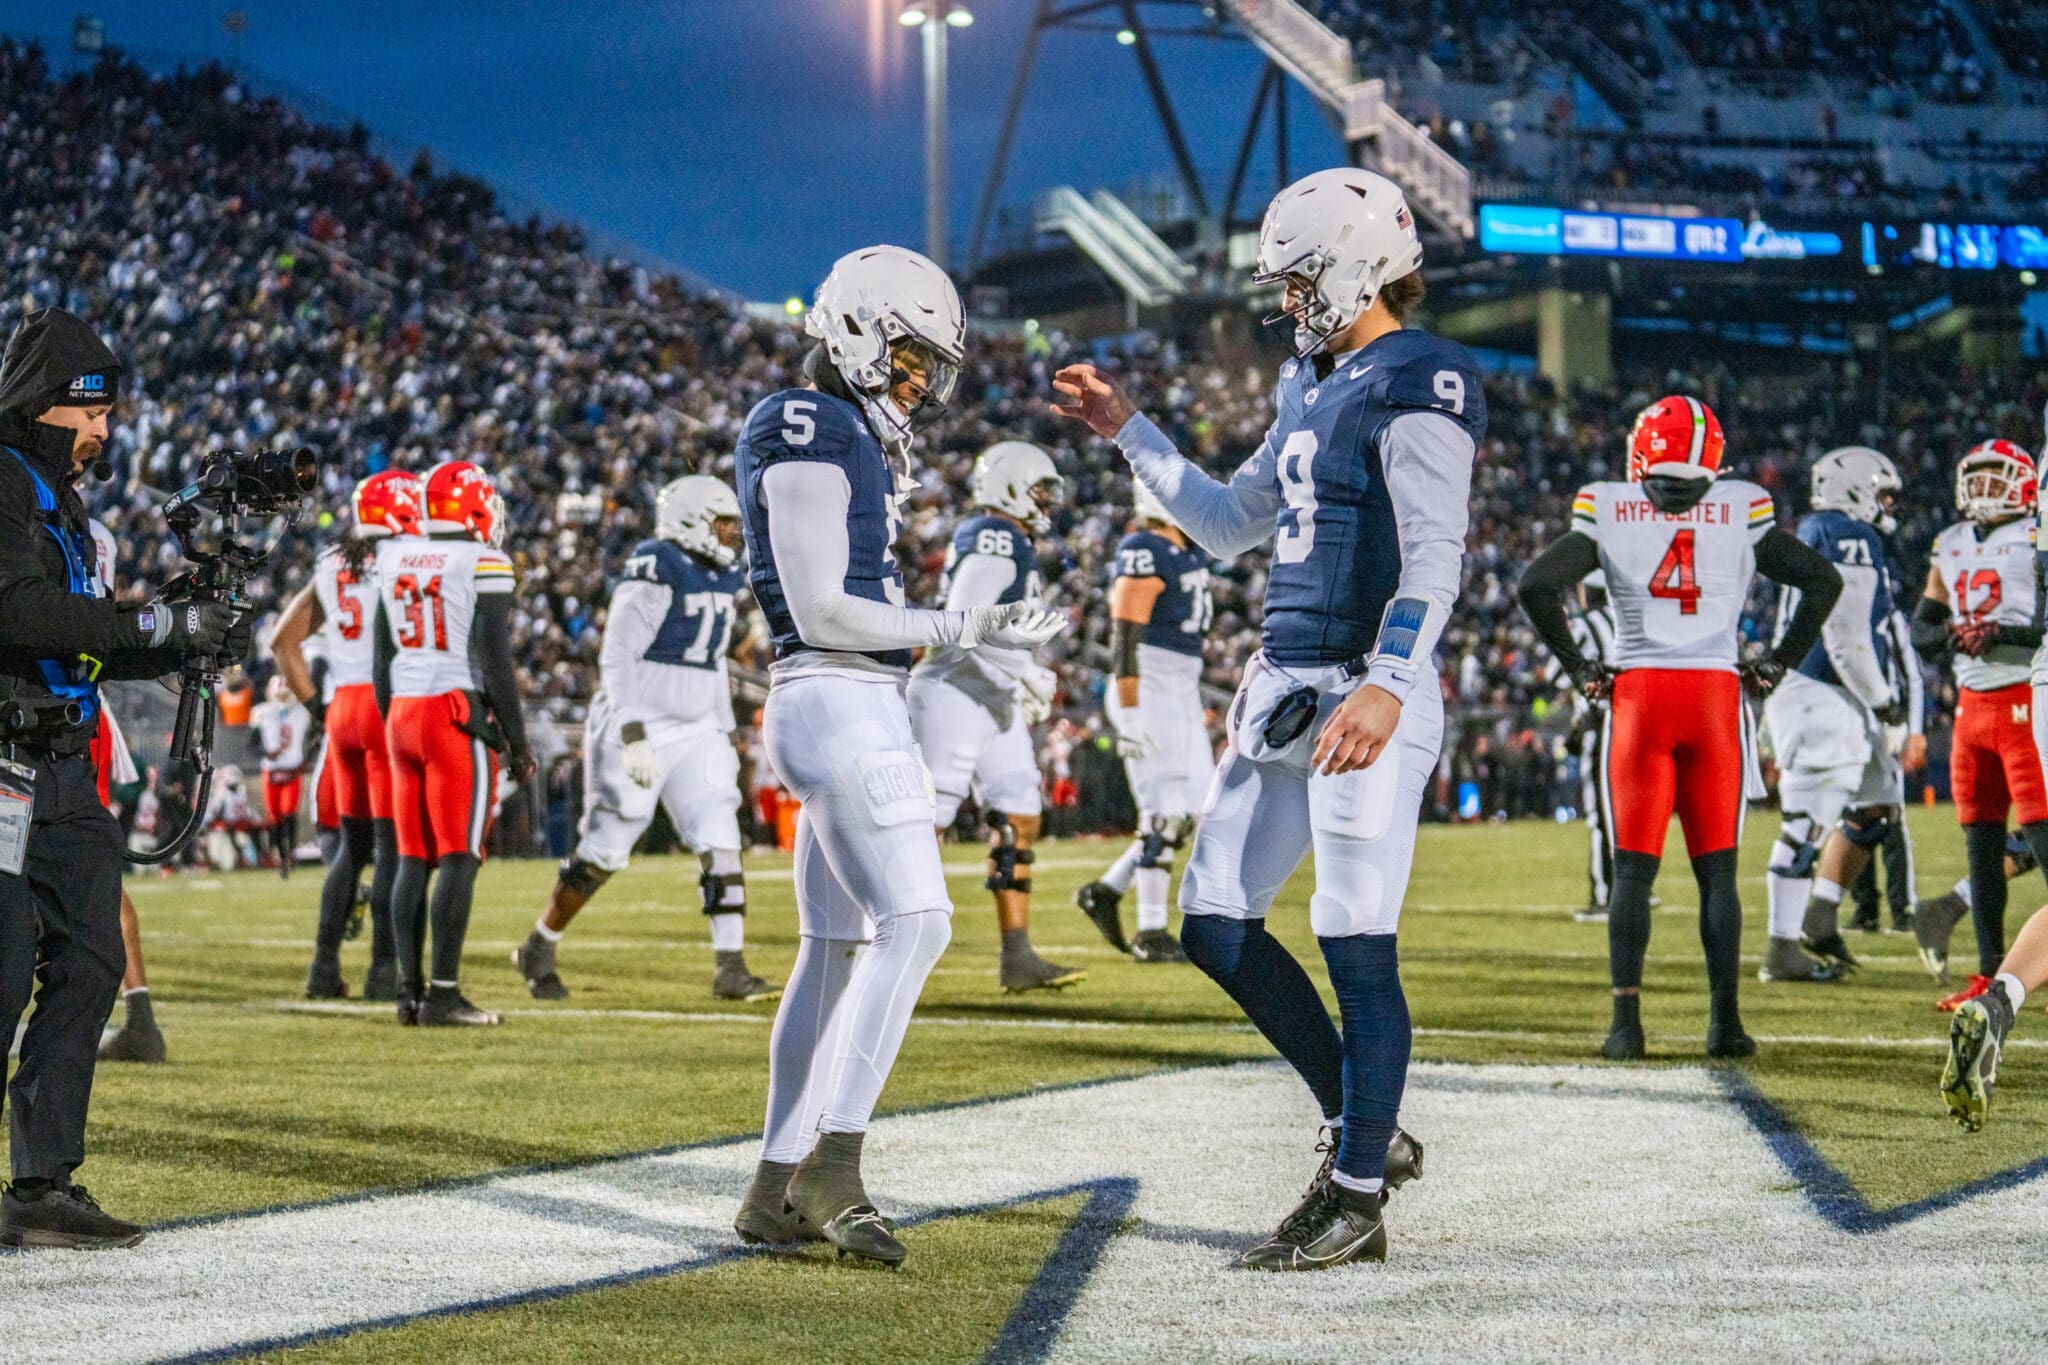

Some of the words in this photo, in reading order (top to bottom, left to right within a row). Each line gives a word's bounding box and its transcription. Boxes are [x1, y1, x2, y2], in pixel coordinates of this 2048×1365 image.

[1431, 370, 1465, 415] 9
[781, 400, 817, 446] 5
[1276, 430, 1318, 563] 9
[399, 553, 448, 571] HARRIS
[977, 529, 1014, 557] 66
[1121, 548, 1156, 574] 72
[1838, 539, 1873, 565] 71
[1648, 528, 1702, 616] 4
[336, 569, 362, 641] 5
[393, 574, 449, 651] 31
[1954, 568, 2003, 622] 12
[683, 591, 737, 663] 77
[2012, 703, 2029, 724] M
[863, 764, 926, 806] #IGL
